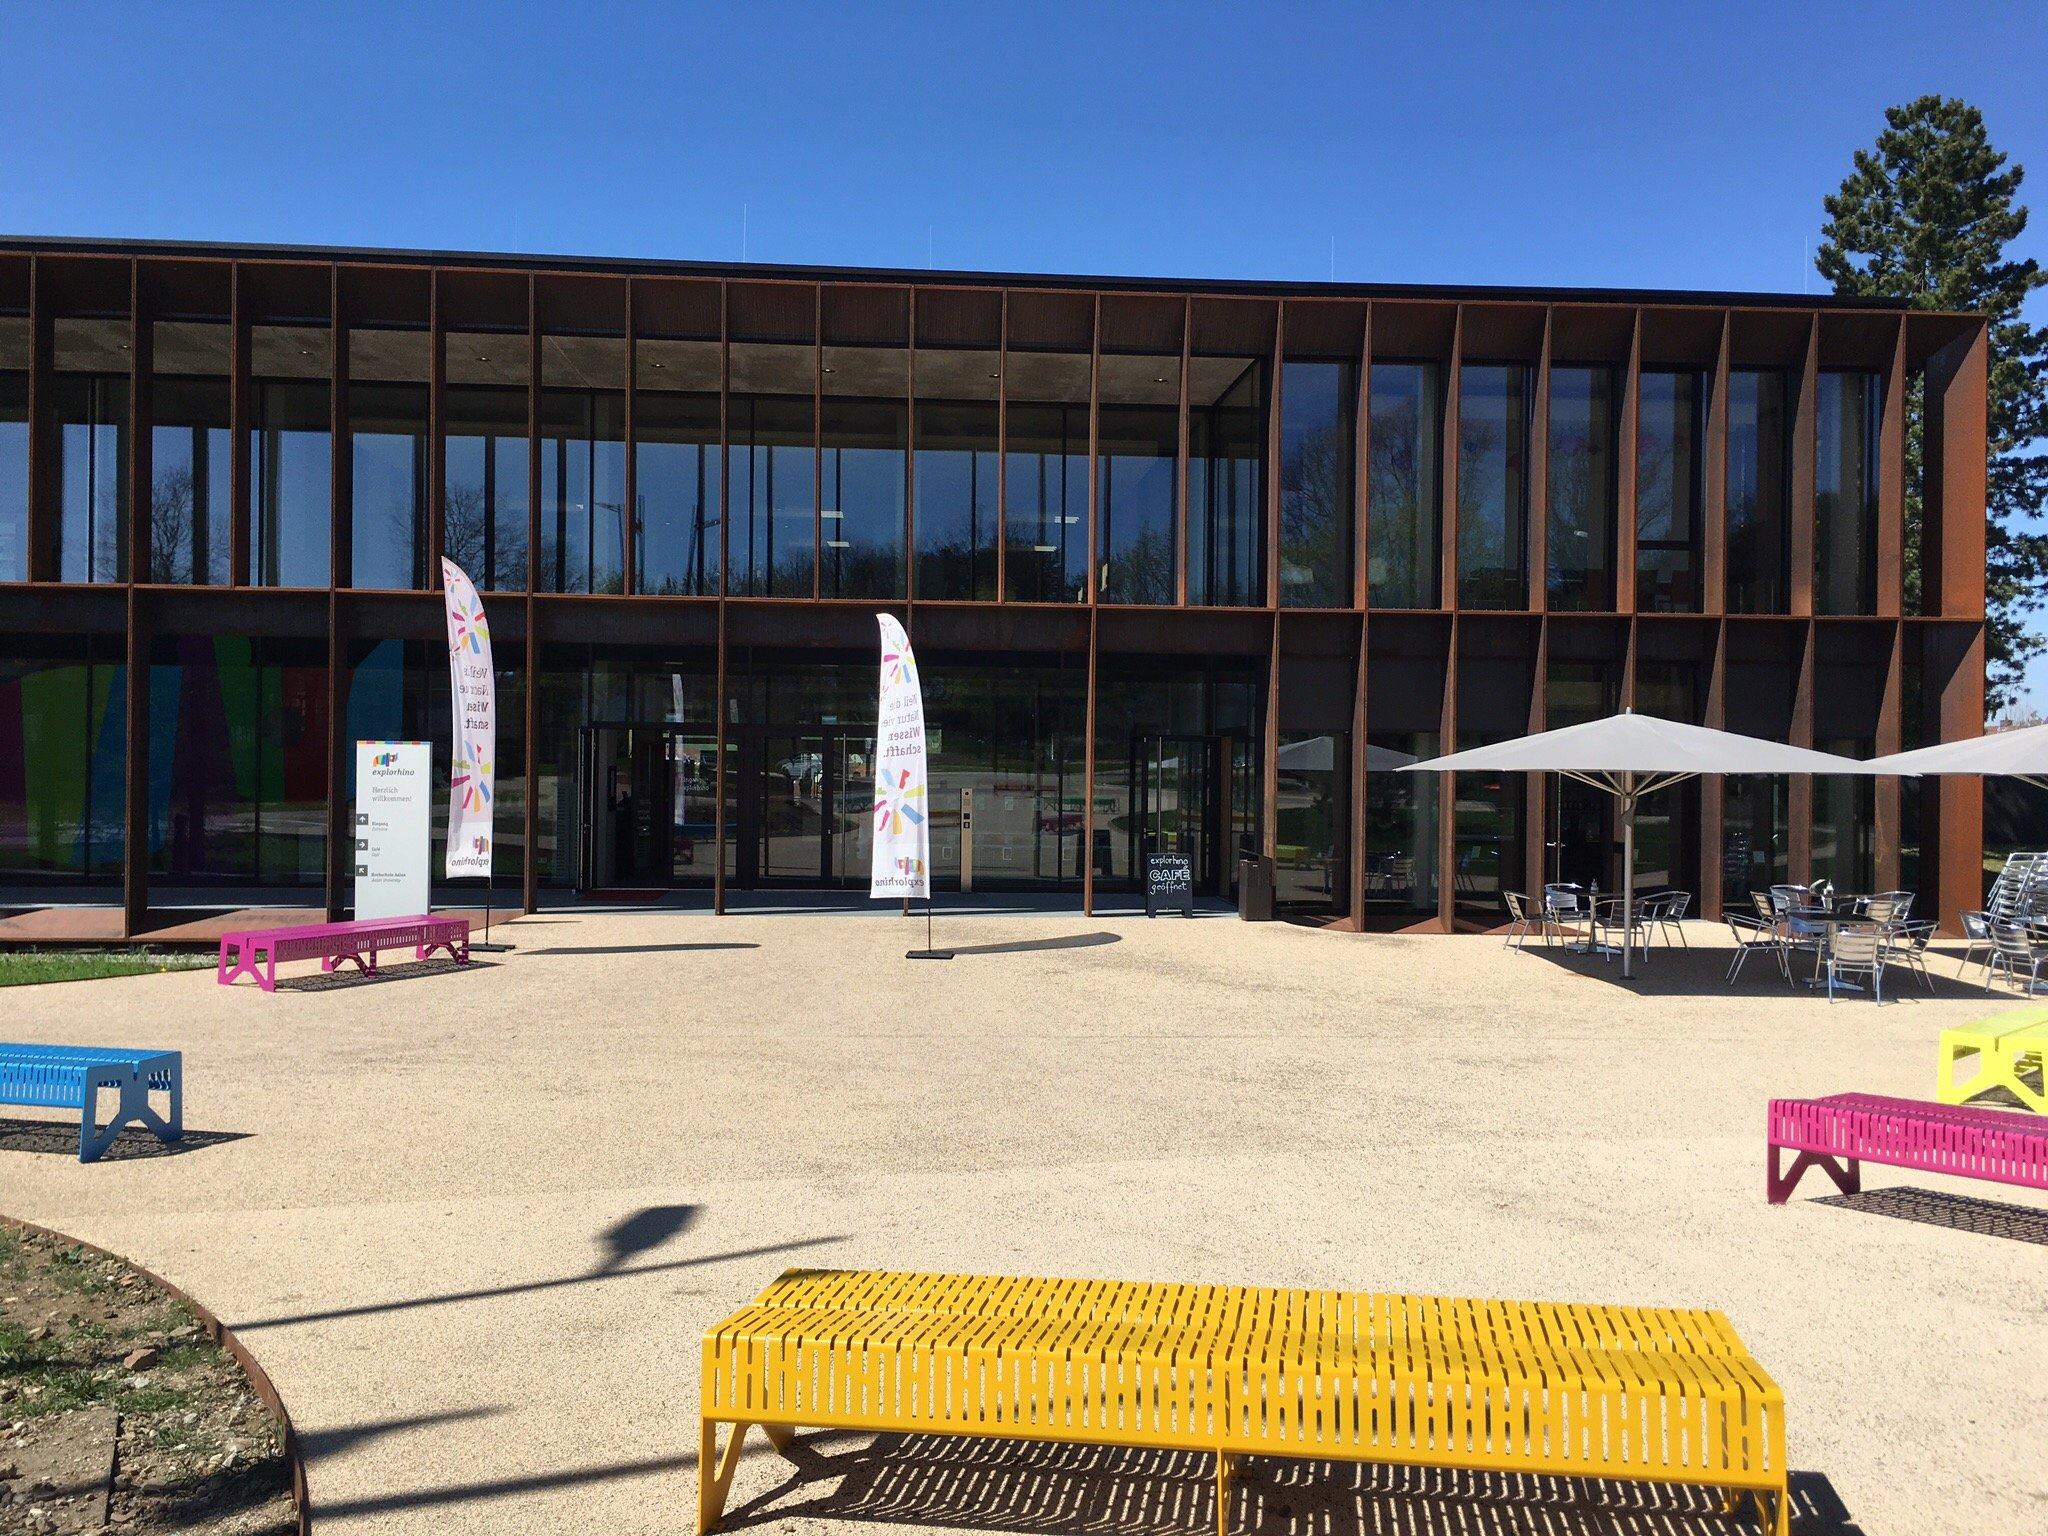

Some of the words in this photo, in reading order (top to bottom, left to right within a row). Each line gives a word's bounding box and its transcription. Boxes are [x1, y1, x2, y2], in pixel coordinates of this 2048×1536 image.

[372, 768, 415, 777] explorhino
[372, 786, 399, 794] Herzlich
[1150, 855, 1189, 867] explorhino
[1149, 865, 1191, 881] CAFÉ
[1150, 880, 1188, 895] geöffnet
